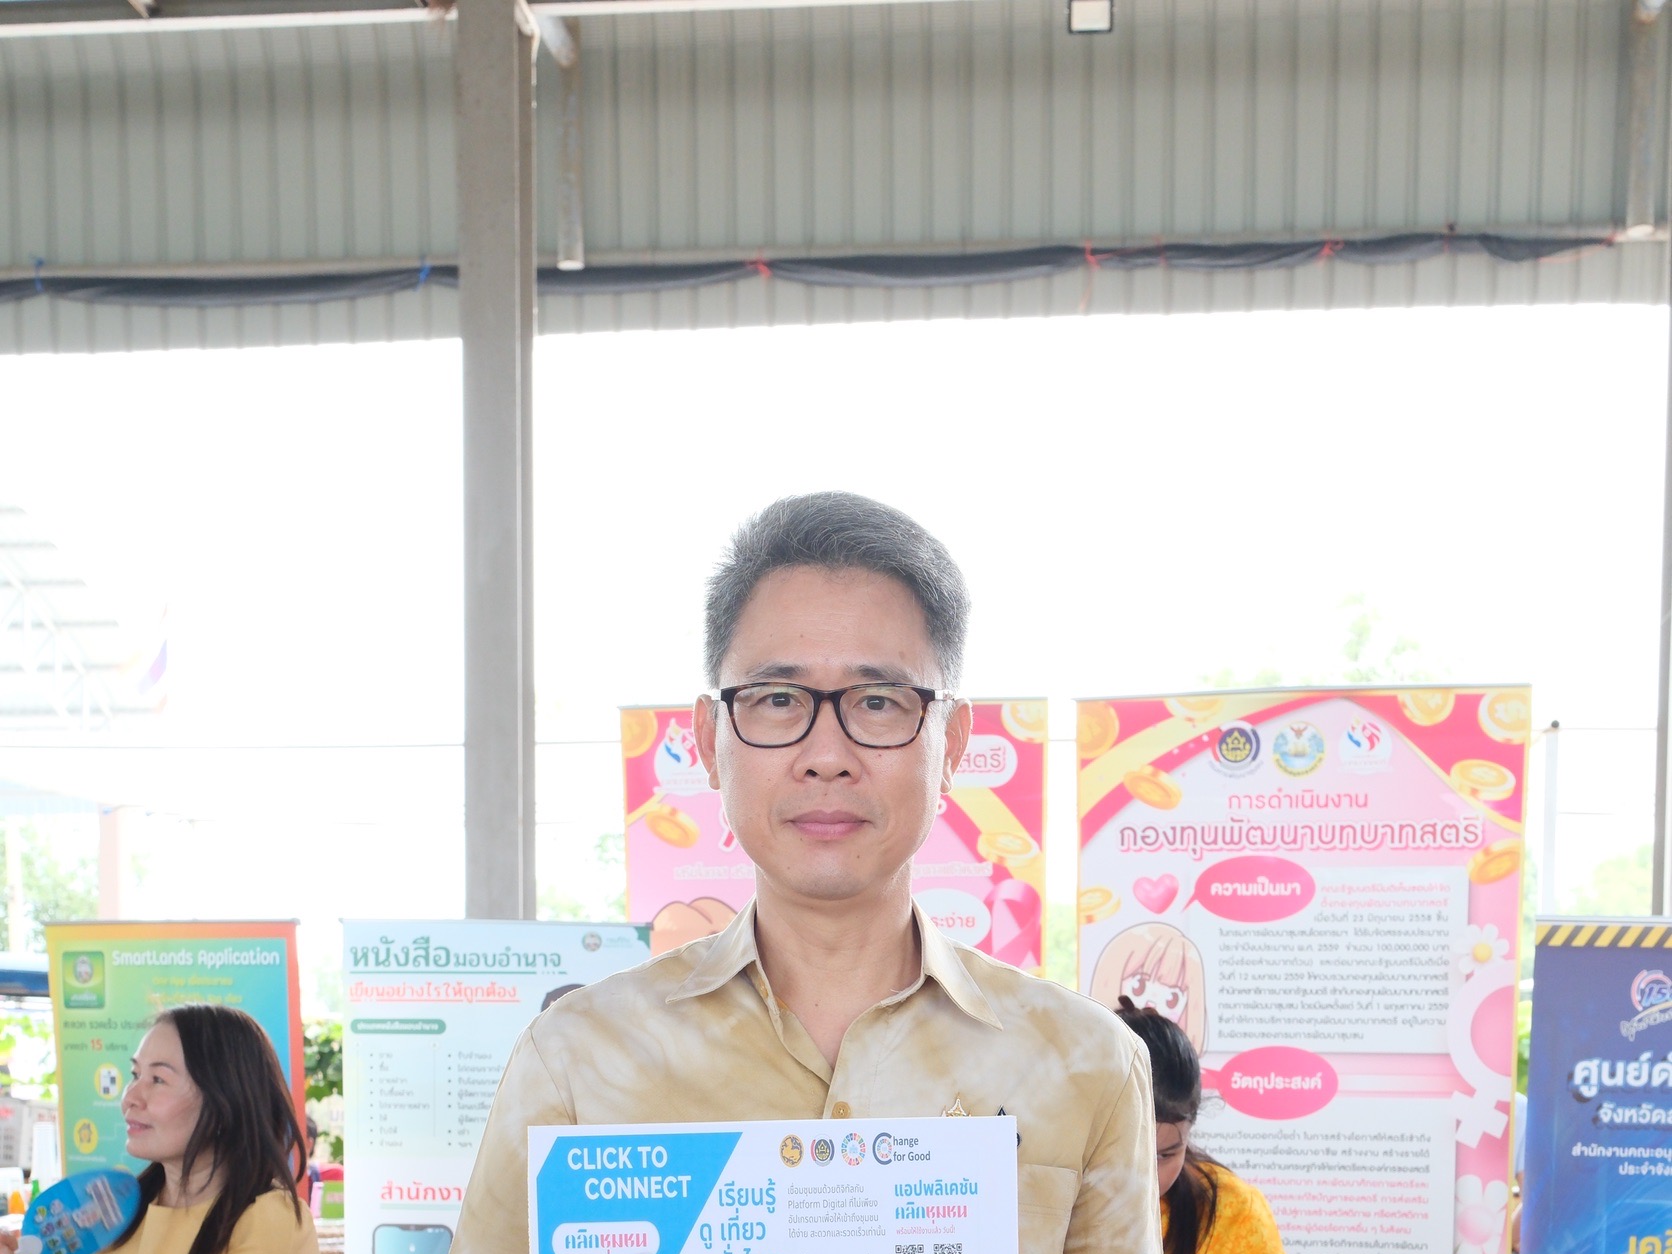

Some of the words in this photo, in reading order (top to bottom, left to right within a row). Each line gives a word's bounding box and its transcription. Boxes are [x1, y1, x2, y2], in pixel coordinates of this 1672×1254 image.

[1228, 787, 1369, 810] การดำเนินงาน
[1119, 815, 1481, 857] กองทุนพัฒนาบทบาทสตรี
[1210, 876, 1301, 896] ความเป็นมา
[112, 949, 193, 966] SmartLands
[198, 947, 280, 969] Application
[350, 981, 517, 1002] เขียนอย่างไรให้ถูกต้อง
[90, 1039, 103, 1051] 15
[1231, 1072, 1322, 1094] วัตถุประสงค์
[1574, 1050, 1672, 1097] ศูนย์ด
[1599, 1102, 1672, 1124] จังหวัด
[567, 1146, 633, 1170] CLICK
[637, 1145, 668, 1168] TO
[893, 1151, 905, 1162] for
[908, 1151, 931, 1162] Good
[1618, 1160, 1672, 1176] ประจำจัง
[584, 1175, 691, 1200] CONNECT
[718, 1178, 776, 1214] เรียนรู้
[894, 1177, 978, 1197] แอปพลิเคชัน
[788, 1200, 820, 1209] Platform
[822, 1199, 847, 1211] Digital
[895, 1201, 967, 1224] คลิกชุมชน
[700, 1222, 712, 1249] ดู
[721, 1207, 766, 1241] เที่ยว
[565, 1228, 647, 1254] คลิกชุมชน
